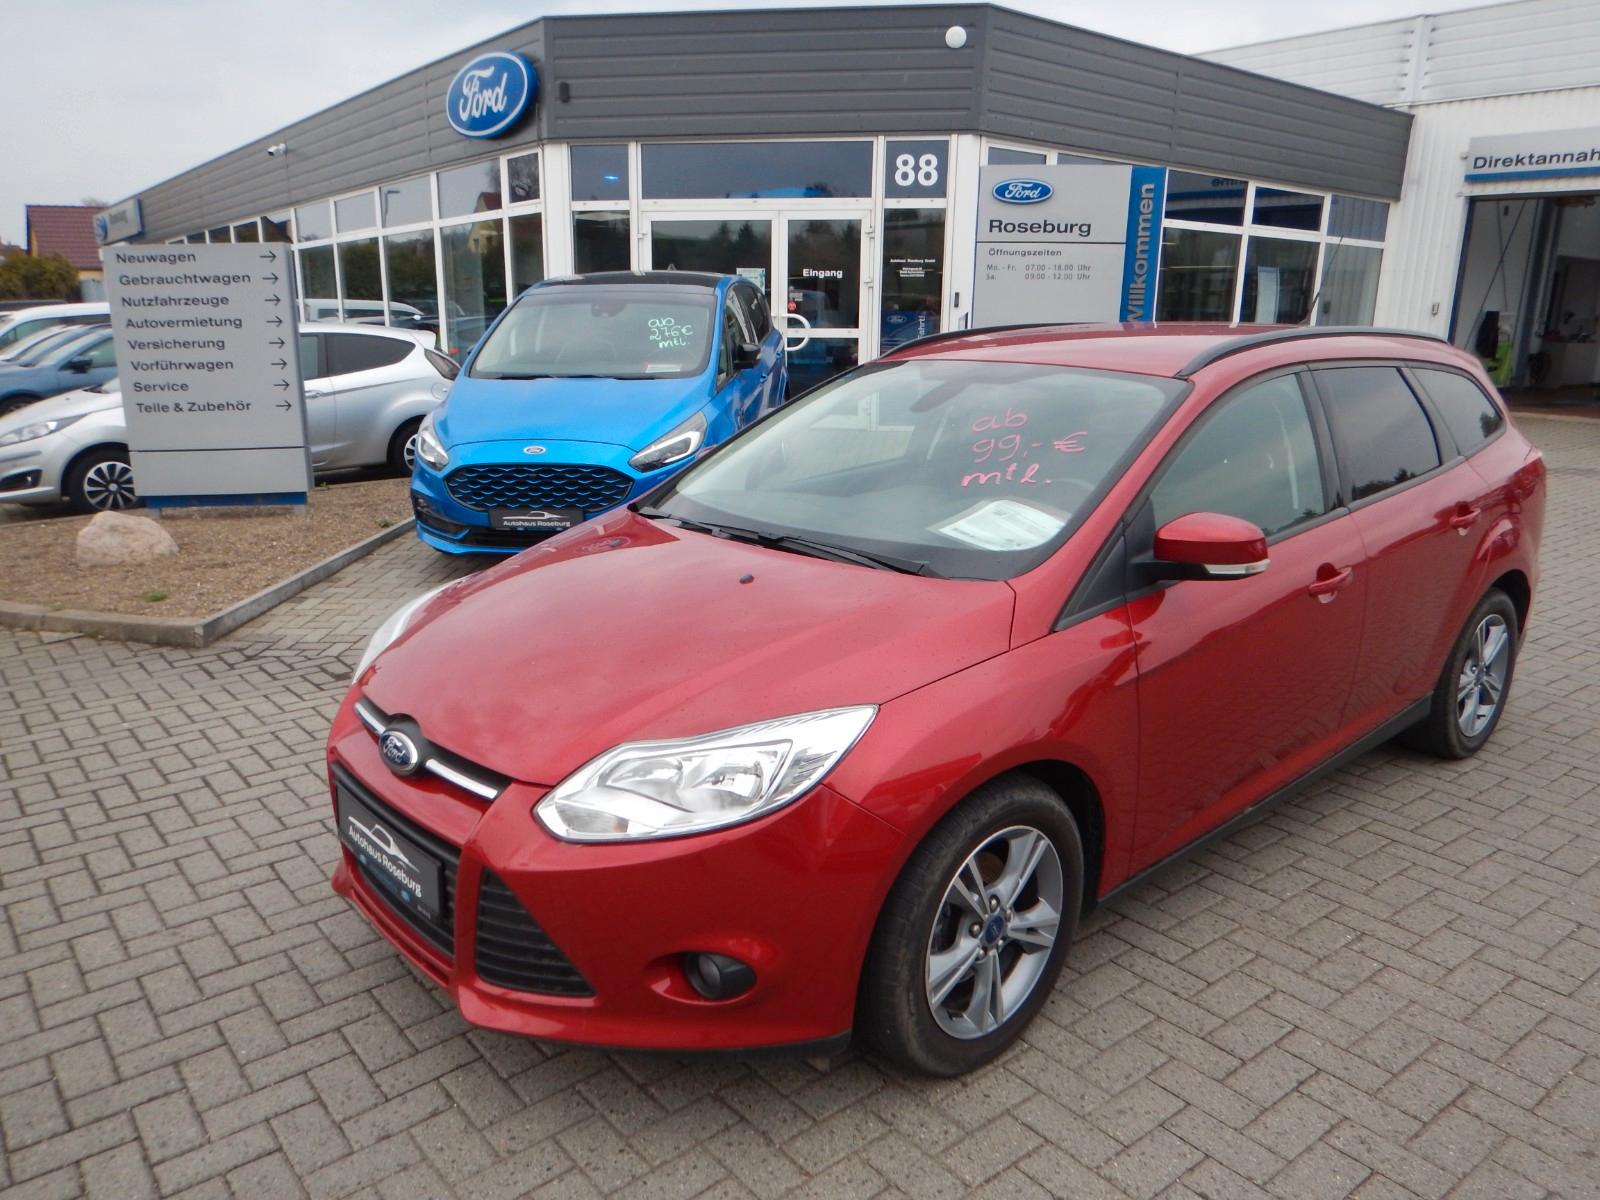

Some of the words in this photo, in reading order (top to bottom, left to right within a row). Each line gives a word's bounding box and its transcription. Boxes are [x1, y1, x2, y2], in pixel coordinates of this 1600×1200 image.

[460, 66, 508, 121] Ford
[1472, 148, 1600, 170] Direktannah
[894, 153, 938, 187] 88
[1004, 182, 1042, 199] Ford
[988, 219, 1092, 237] Roseburg
[115, 252, 197, 265] Neuwagen
[988, 247, 1062, 257] Öffnungszeiten
[802, 268, 843, 279] Eingang
[1077, 263, 1092, 271] Uhr
[119, 273, 251, 286] Gebrauchtwagen
[1077, 272, 1091, 280] Uhr
[121, 296, 230, 308] Nutzfahrzeuge
[125, 317, 243, 329] Autovermietung
[127, 339, 226, 350] Versicherung
[130, 360, 234, 372] Vorführwagen
[133, 382, 190, 393] Service
[136, 402, 169, 414] Teile
[173, 403, 184, 412] &
[187, 401, 252, 413] Zubehör
[971, 407, 1028, 433] ab
[1053, 431, 1088, 453] €
[383, 735, 406, 763] Ford
[348, 825, 382, 863] Autohaus
[382, 854, 423, 897] Roseburg
